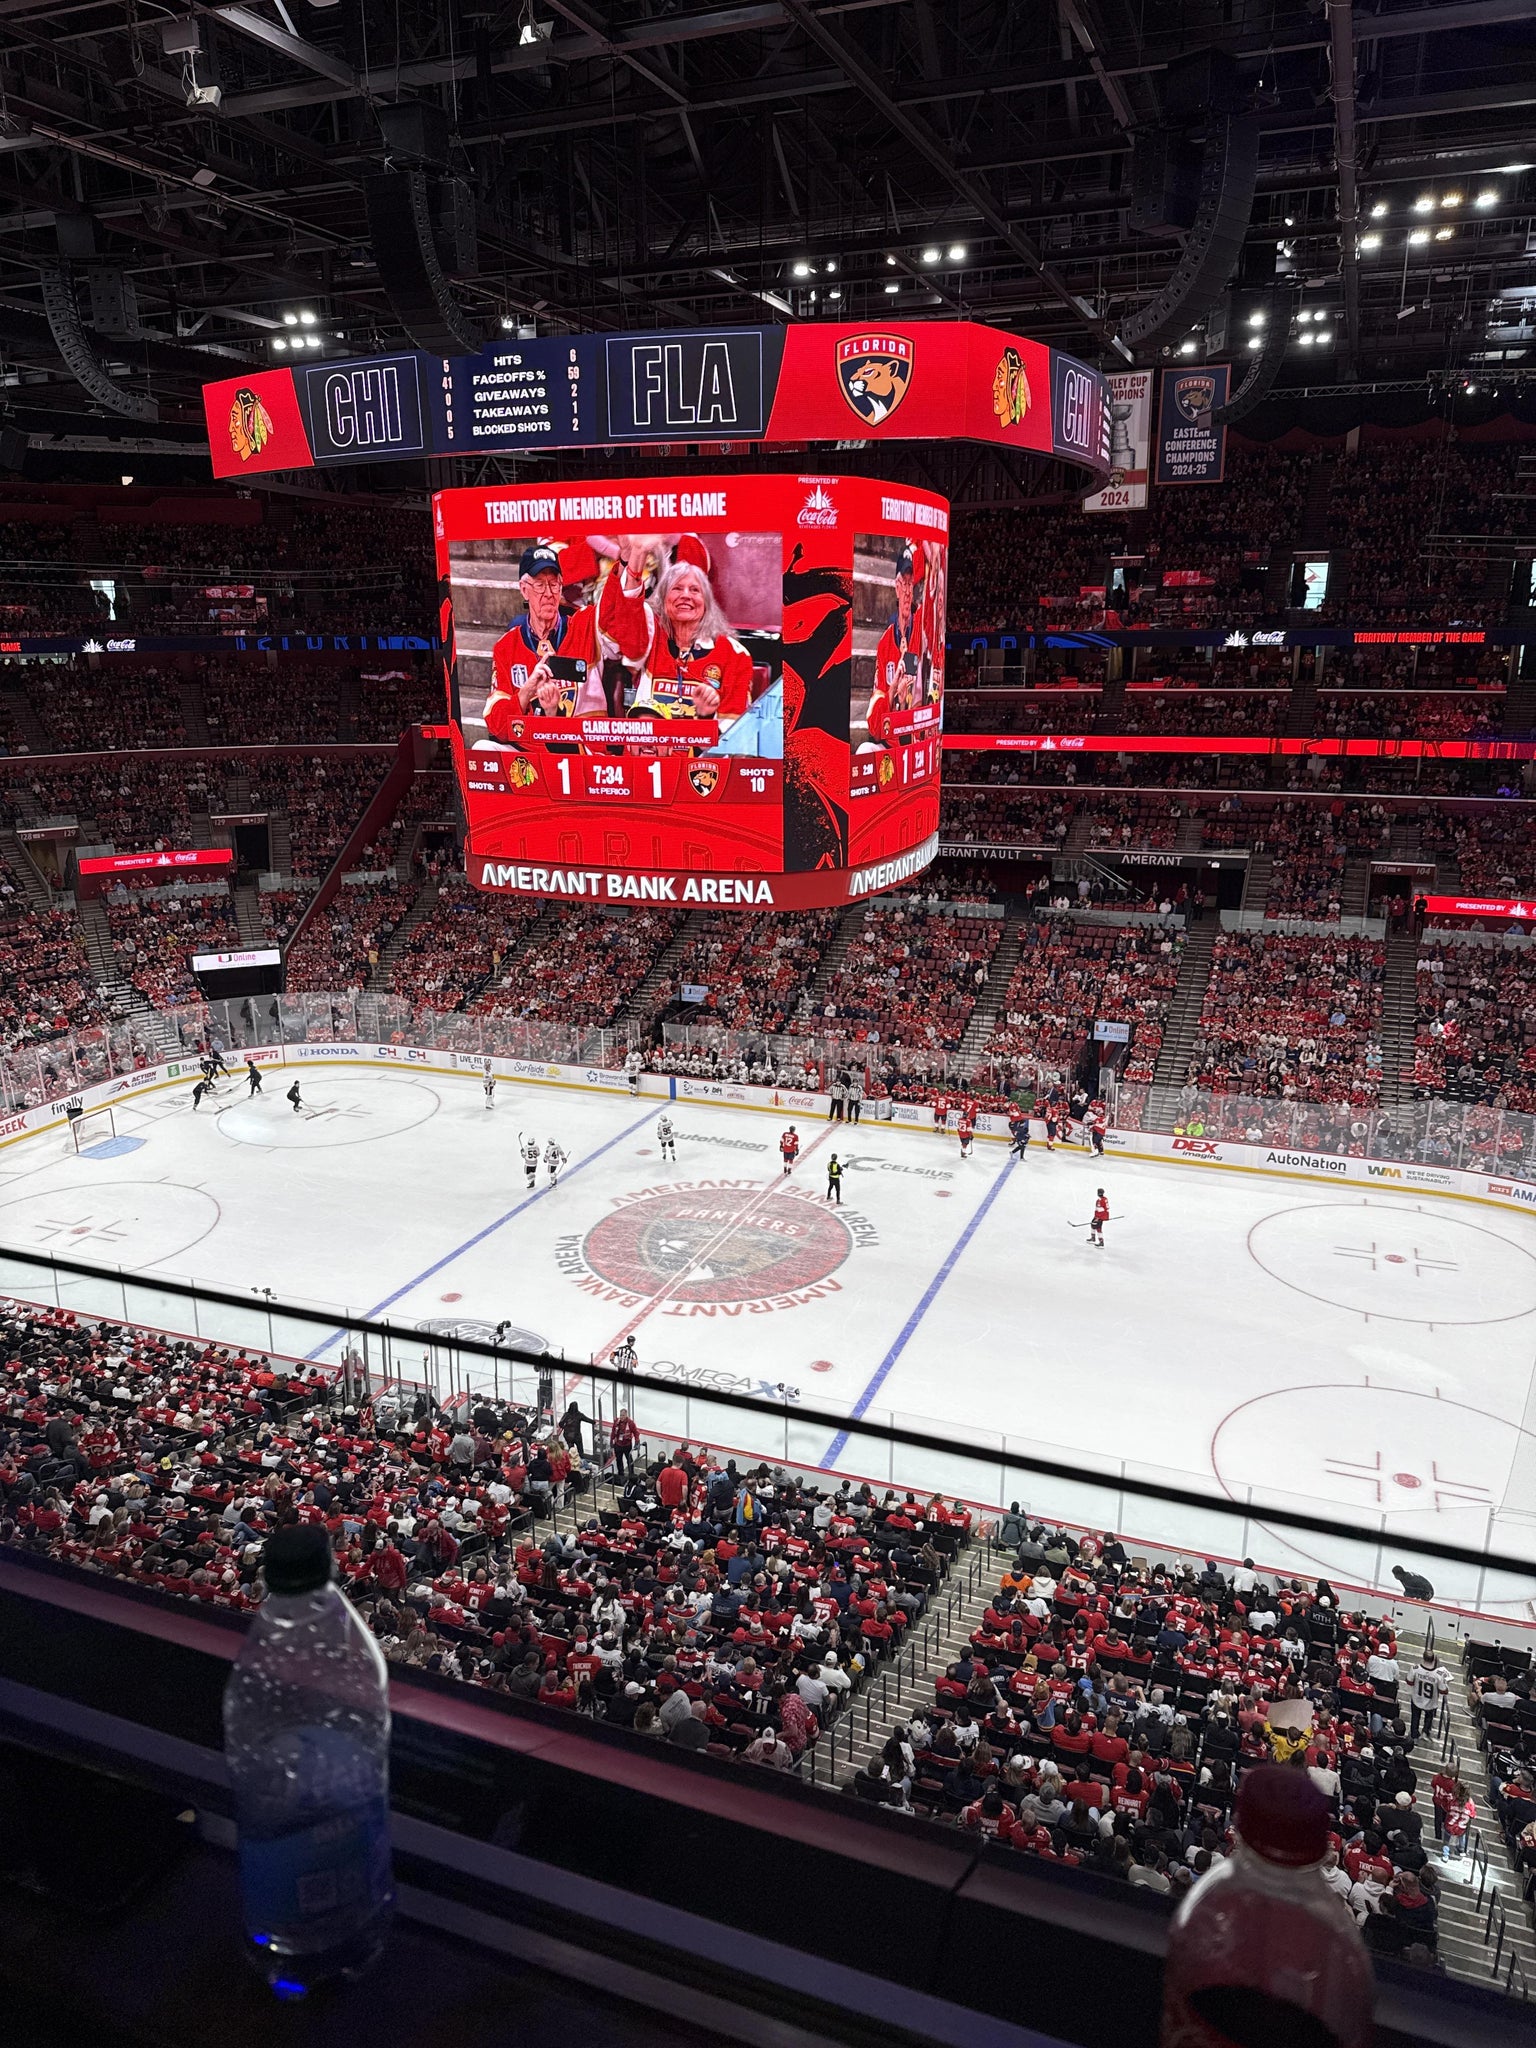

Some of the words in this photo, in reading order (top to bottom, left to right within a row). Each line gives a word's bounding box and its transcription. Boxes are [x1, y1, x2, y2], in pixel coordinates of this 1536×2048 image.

[843, 339, 907, 356] FLORIDA
[443, 359, 450, 373] 5
[494, 355, 522, 367] HITS
[570, 349, 577, 363] 6
[442, 376, 453, 390] 41
[473, 372, 534, 386] FACEOFFS
[536, 370, 547, 381] %
[567, 366, 580, 380] 59
[632, 342, 737, 425] FLA
[1130, 376, 1148, 387] CUP
[445, 393, 452, 407] 0
[474, 388, 547, 403] GIVEAWAYS
[571, 383, 578, 397] 2
[325, 367, 402, 447] CHI
[446, 410, 453, 423] 0
[473, 404, 549, 419] TAKEAWAYS
[572, 400, 577, 414] 1
[1062, 369, 1092, 448] CHI
[447, 426, 454, 440] 5
[472, 423, 517, 436] BLOCKED
[517, 421, 552, 433] SHOTS
[572, 418, 579, 432] 2
[1165, 439, 1217, 451] CONFERENCE
[1165, 451, 1215, 464] CHAMPIONS
[1172, 464, 1207, 476] 2024-25
[831, 477, 839, 485] BY
[1101, 491, 1129, 506] 2024
[485, 498, 557, 524] TERRITORY
[559, 495, 622, 520] MEMBER
[625, 494, 645, 518] OF
[647, 493, 677, 518] THE
[680, 492, 727, 517] GAME
[797, 508, 840, 525] Coca-Cola
[1252, 630, 1287, 643] Coca-Cola
[1354, 633, 1397, 643] TERRITORY
[1398, 632, 1433, 643] MEMBER
[1433, 632, 1444, 642] OF
[1445, 632, 1461, 642] THE
[1462, 632, 1486, 643] GAME
[0, 642, 22, 652] GAME
[106, 639, 136, 650] Coca-Cola
[657, 683, 697, 696] PANTHE
[582, 720, 610, 734] CLARK
[611, 721, 653, 735] COCHRAN
[552, 733, 584, 741] FLORIDA,
[584, 734, 625, 742] TERRITORY
[626, 735, 658, 743] MEMBER
[1059, 737, 1086, 747] Coca-Cola
[468, 760, 477, 772] 55
[483, 762, 499, 773] 2:00
[902, 749, 908, 784] 1
[928, 741, 933, 775] 1
[557, 758, 571, 795] 1
[592, 765, 624, 786] 7:34
[739, 768, 774, 777] SHOTS
[851, 766, 859, 778] 55
[648, 761, 662, 799] 1
[750, 778, 765, 792] 10
[468, 782, 495, 792] SHOTS:
[498, 784, 505, 792] 3
[588, 787, 599, 795] 1st
[599, 787, 630, 796] PERIOD
[850, 788, 870, 797] SHOTS:
[982, 849, 1021, 860] VAULT
[1121, 854, 1183, 866] AMERANT
[114, 858, 146, 866] PRESENTED
[849, 853, 916, 896] AMERANT
[481, 863, 605, 897] AMERANT
[605, 874, 678, 901] BANK
[681, 879, 775, 905] ARENA
[1455, 902, 1495, 911] PRESENTED
[233, 953, 256, 962] Online
[1108, 1026, 1129, 1035] Online
[243, 1050, 279, 1062] ESPN
[378, 1047, 397, 1056] CH
[408, 1050, 426, 1059] CH
[459, 1055, 472, 1063] LIVE
[514, 1061, 545, 1074] Surfside
[131, 1071, 157, 1083] ACTION
[51, 1096, 84, 1115] finally
[788, 1095, 815, 1107] Coca-Cola
[785, 1137, 793, 1146] 12
[1171, 1138, 1220, 1154] DEX
[1182, 1150, 1223, 1161] imaging
[1266, 1152, 1347, 1170] AutoNation
[880, 1163, 955, 1179] CELSIUS
[1368, 1165, 1402, 1178] WM
[1426, 1172, 1450, 1180] DRIVING
[610, 1178, 765, 1208] AMERANT
[836, 1210, 880, 1248] ARENA
[675, 1209, 801, 1236] PANTHERS
[554, 1234, 588, 1276] ARENA
[570, 1274, 647, 1309] BANK
[661, 1277, 844, 1317] AMERANT
[651, 1360, 752, 1390] OMEGA
[1312, 1612, 1331, 1624] KITH
[1418, 1680, 1435, 1700] 19
[756, 1696, 768, 1714] 11
[1448, 1811, 1470, 1829] 72
